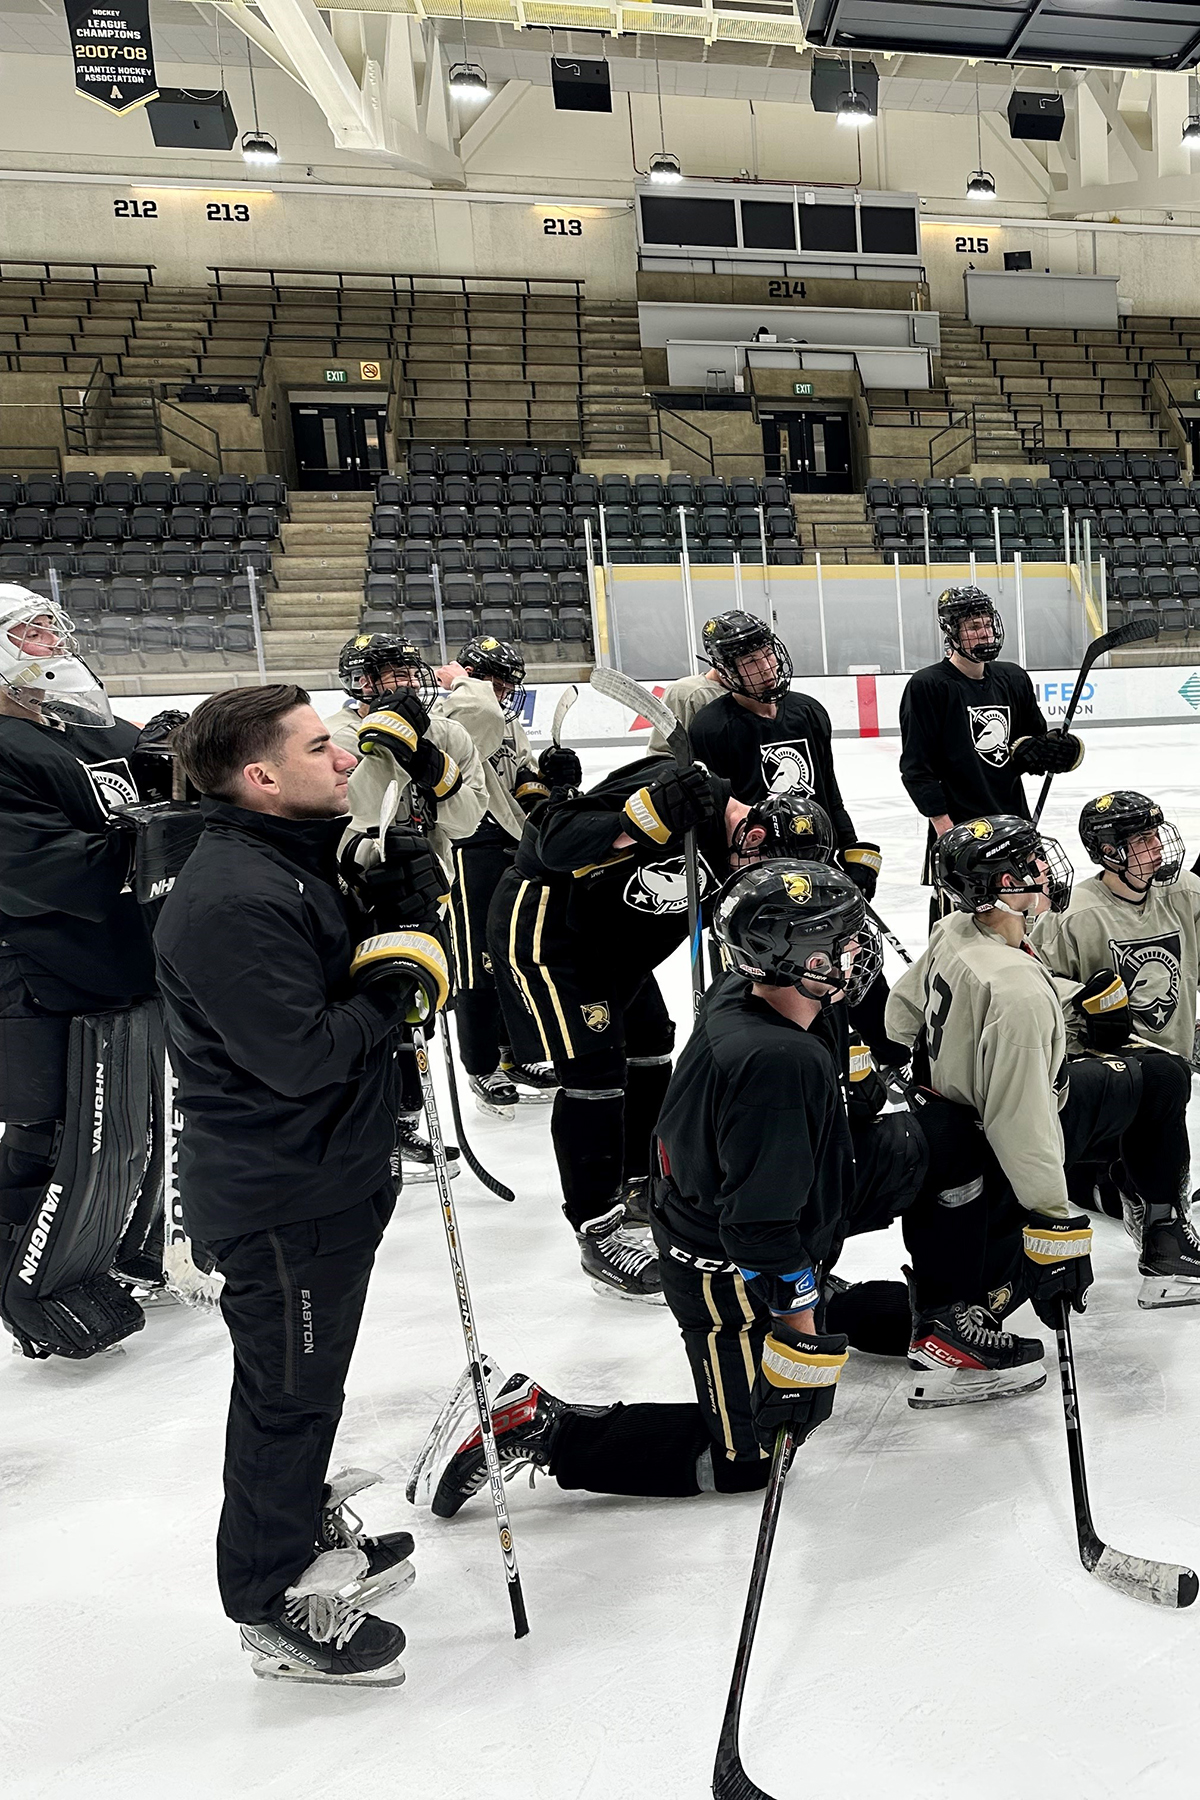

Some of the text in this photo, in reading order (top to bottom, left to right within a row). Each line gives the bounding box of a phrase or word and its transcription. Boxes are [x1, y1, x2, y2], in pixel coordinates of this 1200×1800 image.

[92, 9, 120, 17] HOCKEY
[88, 19, 127, 29] LEAGUE
[76, 29, 141, 40] CHAMPIONS
[75, 45, 147, 60] 2007-08
[76, 66, 152, 76] ATLANTIC HOCKEY
[85, 74, 145, 84] ASSOCIATION
[114, 200, 158, 218] 212
[206, 203, 250, 222] 213
[543, 218, 583, 237] 213
[954, 237, 989, 254] 215
[768, 281, 807, 299] 214
[326, 370, 344, 381] EXIT
[795, 384, 811, 394] EXIT
[28, 698, 75, 716] BAUER
[1048, 704, 1093, 715] UNON
[985, 840, 1010, 858] BAUER
[91, 1063, 105, 1155] VAUGHN
[422, 1084, 446, 1168] EASTON
[18, 1183, 63, 1285] VAUGHN
[301, 1289, 314, 1354] EASTON
[796, 1341, 818, 1352] ARMY
[924, 1340, 963, 1366] CCM
[781, 1392, 801, 1400] ALPHA
[484, 1439, 507, 1517] EASTON
[277, 1637, 318, 1667] BAUER
